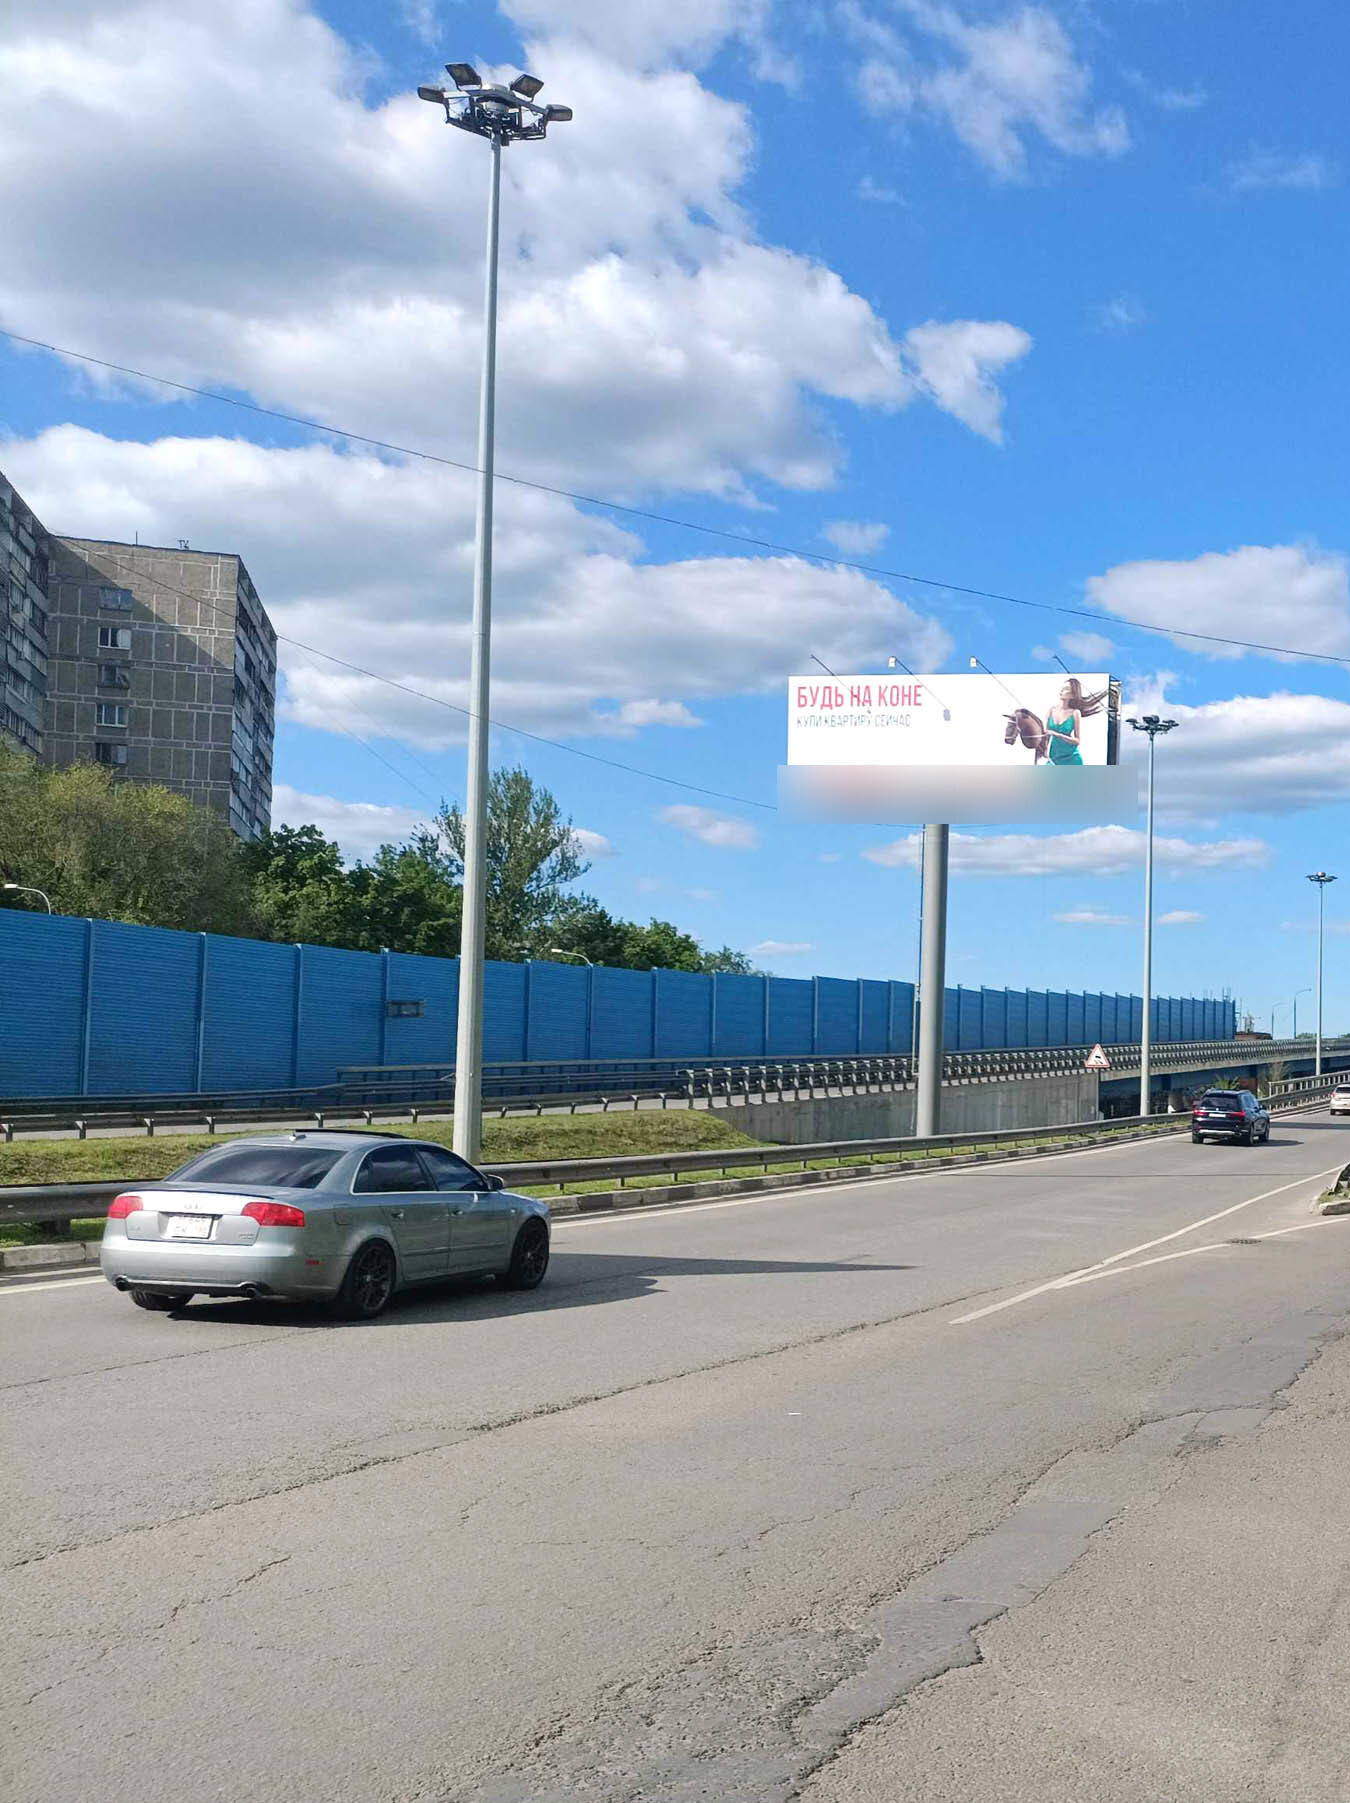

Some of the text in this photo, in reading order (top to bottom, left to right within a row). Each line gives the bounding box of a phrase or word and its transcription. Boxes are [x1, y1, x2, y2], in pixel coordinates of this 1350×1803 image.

[797, 684, 923, 710] БУДЬ НА КОНЕ
[796, 714, 823, 728] КУПИ
[823, 714, 872, 728] КВАРТИРУ
